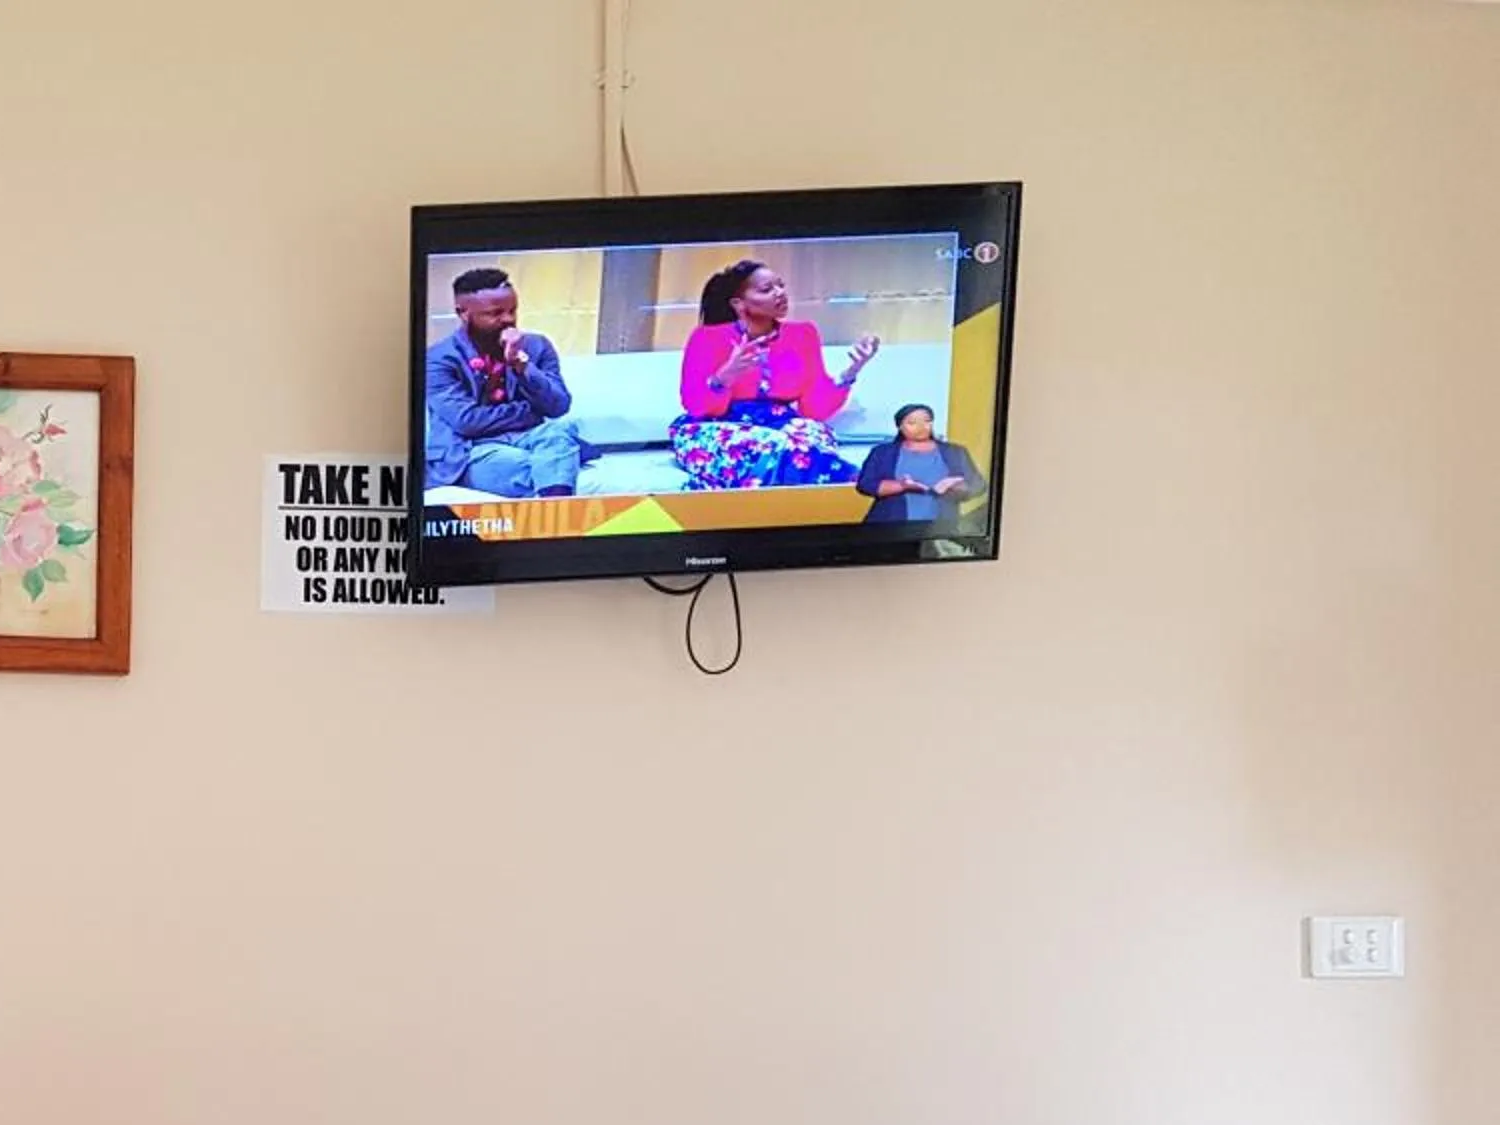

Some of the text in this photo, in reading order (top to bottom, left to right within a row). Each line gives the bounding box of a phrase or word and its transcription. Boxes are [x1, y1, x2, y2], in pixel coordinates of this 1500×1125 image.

[278, 463, 405, 507] TAKE N
[285, 515, 408, 543] NO LOUD M
[423, 517, 514, 537] ILYTHETHA
[296, 547, 408, 573] OR ANY N
[303, 577, 445, 605] IS ALLOWED.
